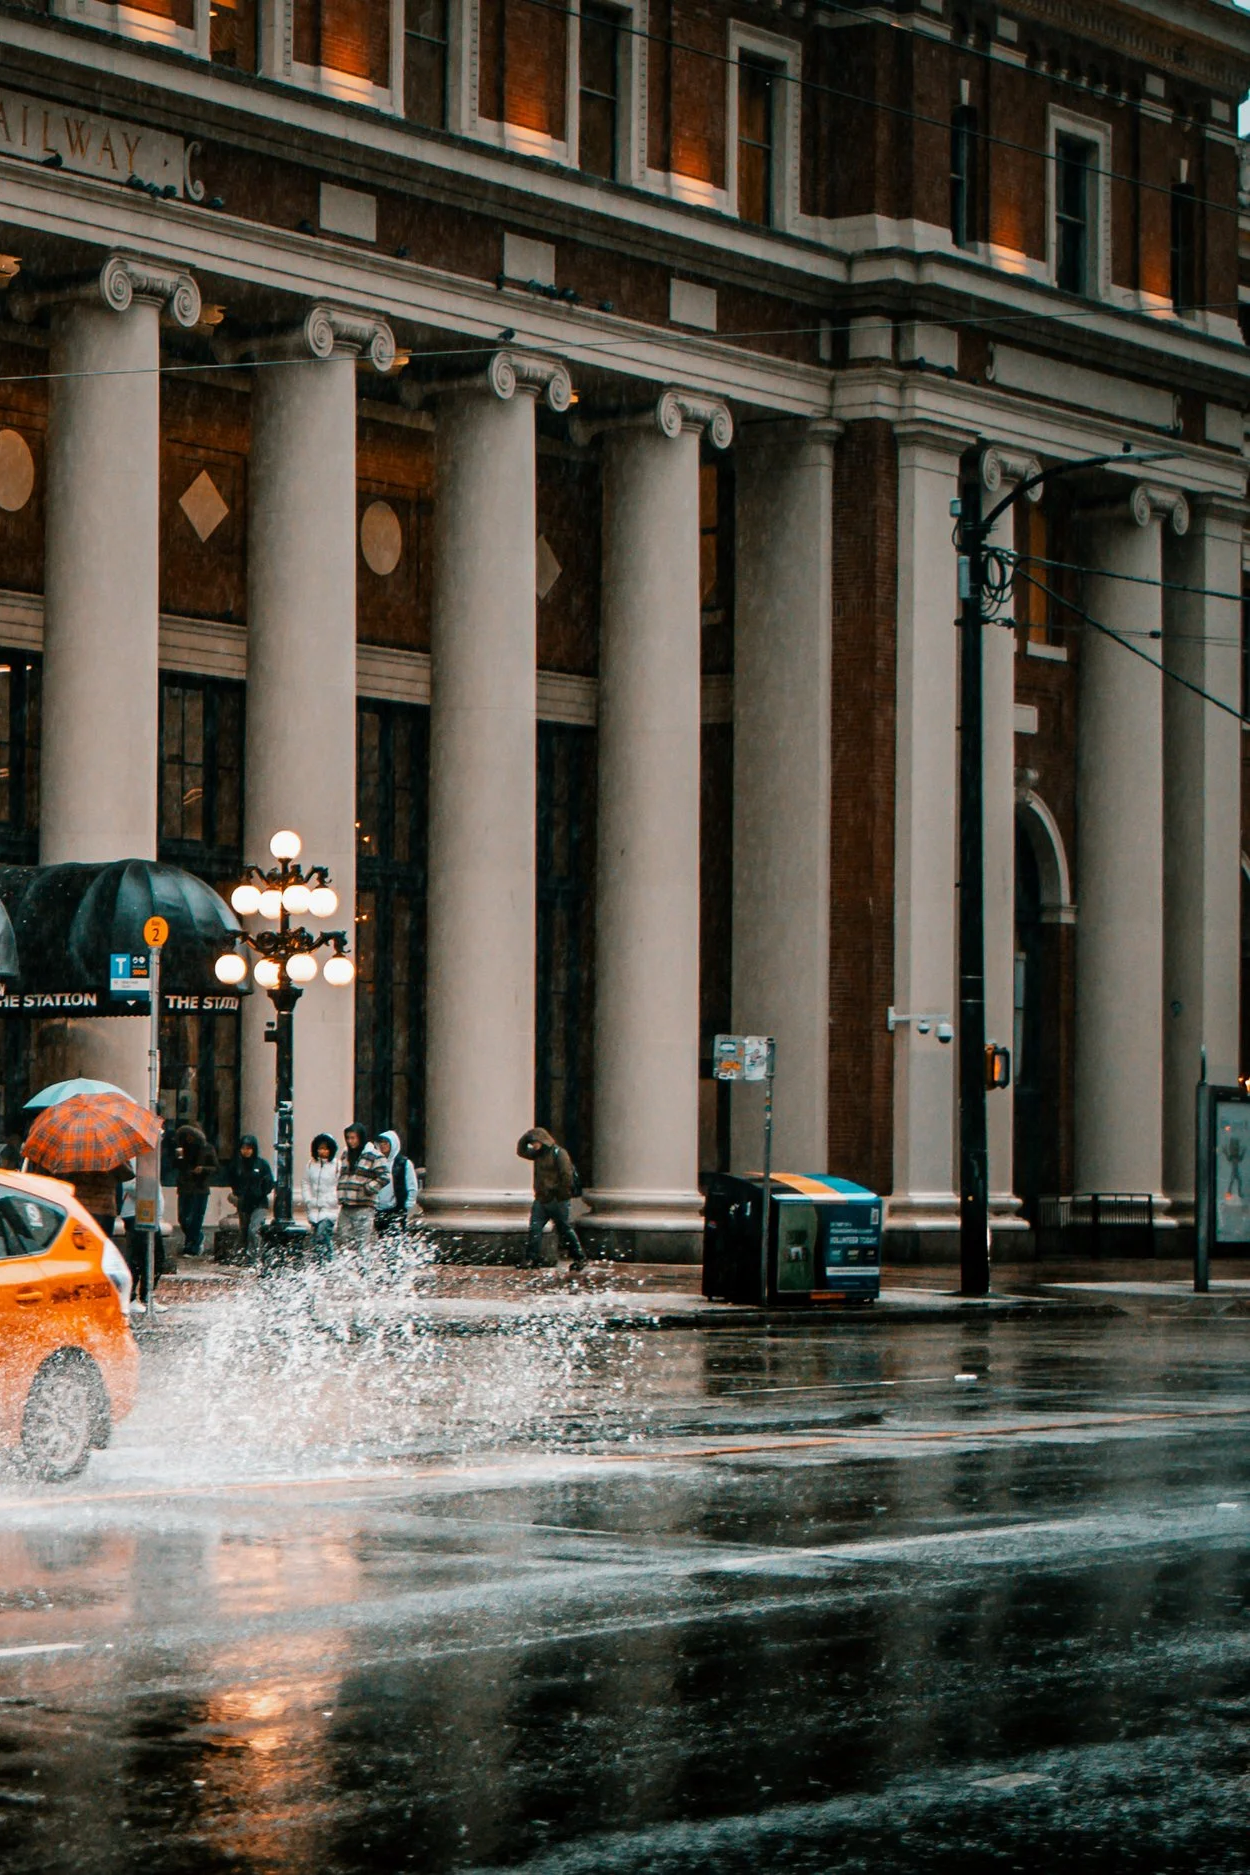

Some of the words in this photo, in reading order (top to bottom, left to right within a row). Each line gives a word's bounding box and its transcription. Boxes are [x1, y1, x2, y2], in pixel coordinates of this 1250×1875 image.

[152, 928, 160, 942] 2
[23, 993, 98, 1008] STATION
[165, 995, 199, 1010] THE
